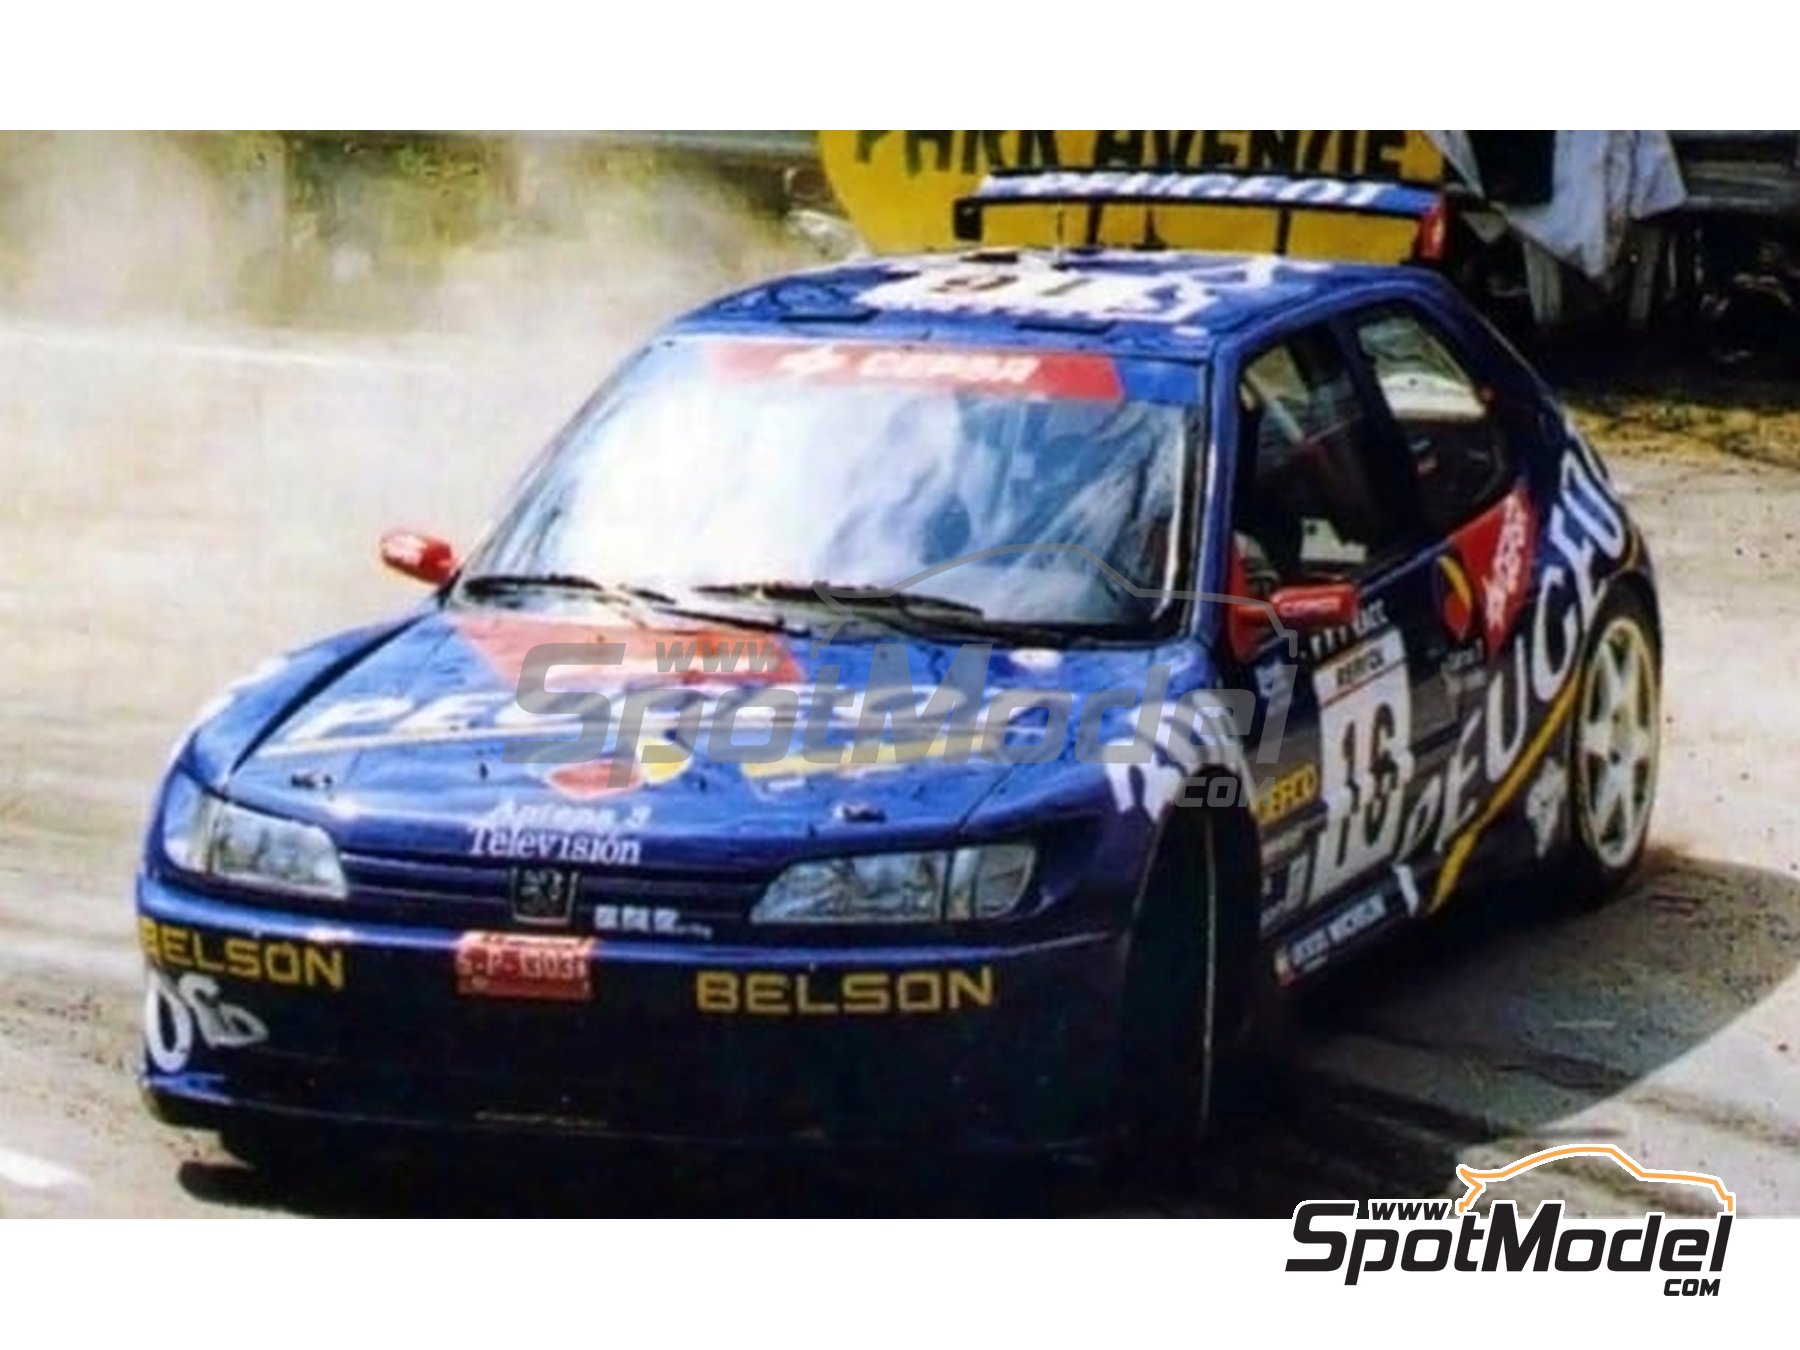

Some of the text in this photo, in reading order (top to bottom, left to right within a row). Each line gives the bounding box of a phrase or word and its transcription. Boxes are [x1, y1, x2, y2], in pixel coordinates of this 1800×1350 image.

[467, 824, 642, 866] Televisión
[137, 917, 345, 989] BELSON
[696, 966, 993, 1015] BELSON
